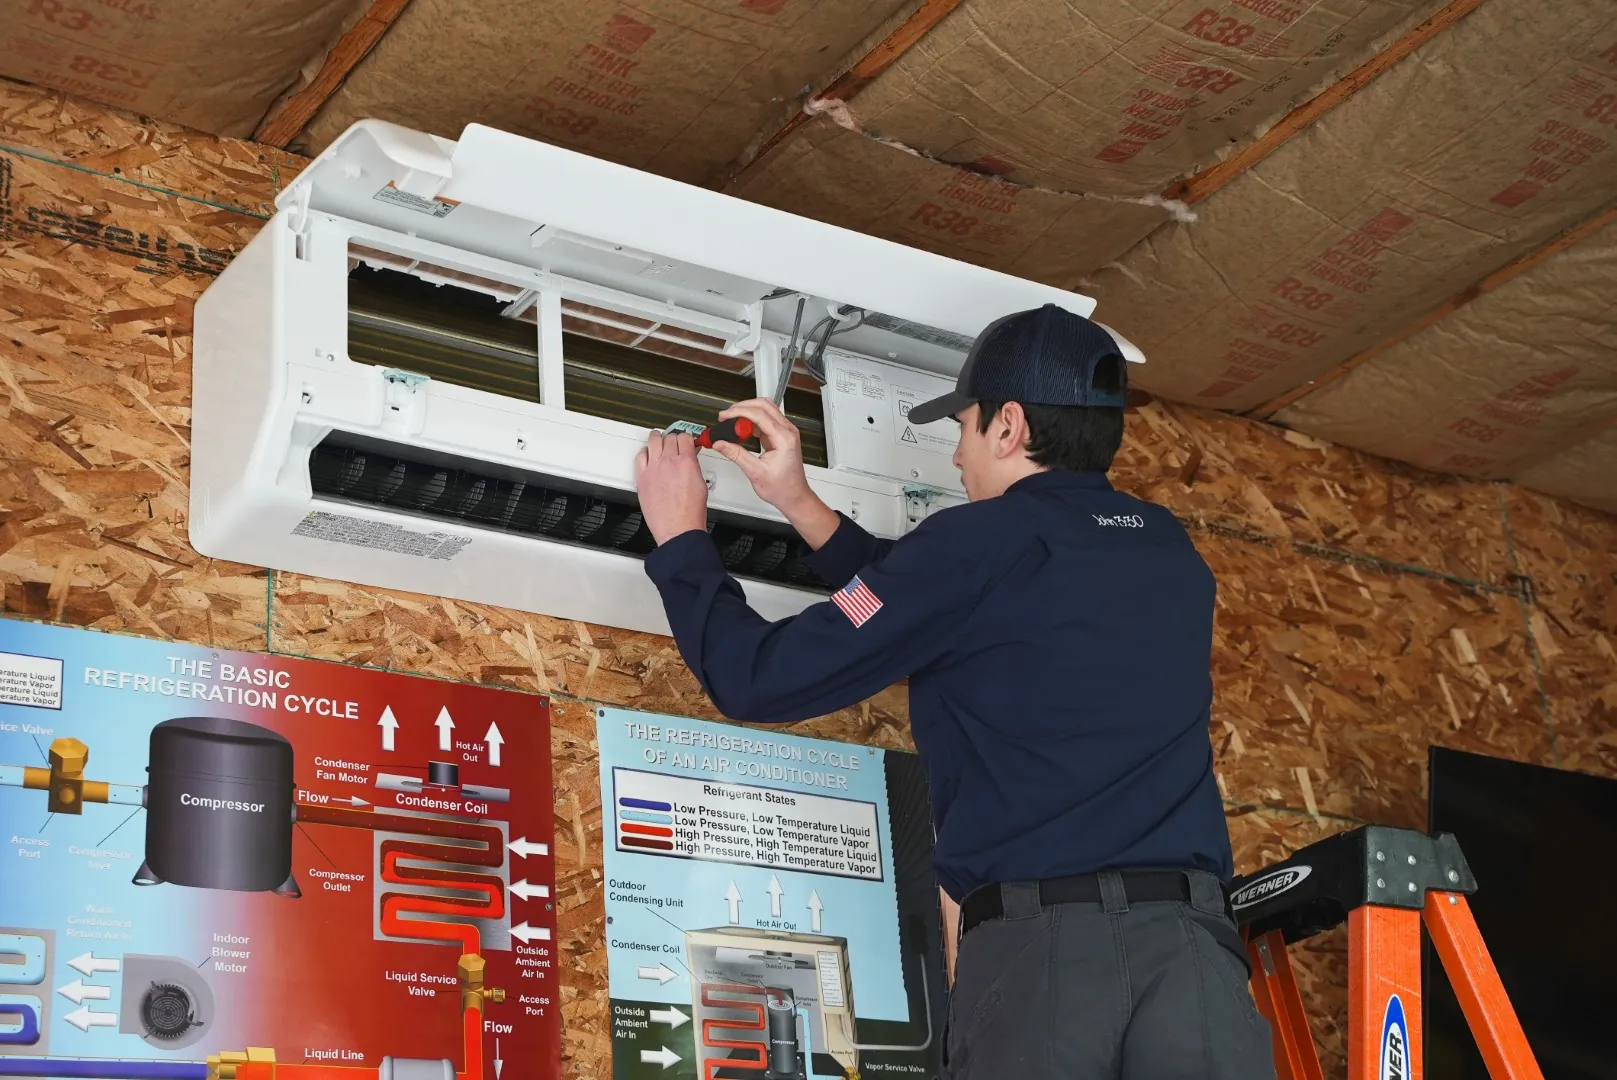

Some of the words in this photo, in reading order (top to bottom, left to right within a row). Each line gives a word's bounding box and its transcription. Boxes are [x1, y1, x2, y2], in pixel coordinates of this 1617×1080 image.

[1181, 8, 1256, 48] R38
[1174, 66, 1245, 95] R38
[1118, 121, 1171, 141] PINK
[938, 182, 1018, 214] FIBERGLAS
[909, 202, 979, 237] R38
[1270, 277, 1334, 311] R38
[30, 672, 56, 682] Liquid
[166, 656, 213, 680] THE
[219, 664, 291, 690] BASIC
[29, 680, 54, 689] Vapor
[0, 685, 30, 694] erature
[33, 688, 59, 698] Liquid
[83, 666, 277, 710] REFRIGERATION
[284, 694, 359, 720] CYCLE
[32, 696, 57, 706] Vapor
[22, 723, 54, 736] Valve
[456, 741, 471, 751] Hot
[472, 743, 484, 752] Air
[625, 721, 661, 742] THE
[665, 727, 802, 762] REFRIGERATION
[807, 749, 861, 771] CYCLE
[462, 752, 478, 762] Out
[314, 756, 370, 772] Condenser
[643, 748, 668, 765] OF
[671, 752, 698, 770] AN
[701, 755, 732, 774] AIR
[735, 760, 849, 792] CONDITIONER
[316, 770, 338, 782] Fan
[340, 771, 368, 785] Motor
[298, 790, 329, 804] Flow
[703, 784, 762, 801] Refrigerant
[765, 792, 796, 806] States
[180, 792, 265, 814] Compressor
[395, 793, 461, 813] Condenser
[464, 800, 489, 815] Coil
[674, 802, 696, 814] Low
[699, 805, 749, 822] Pressure,
[752, 812, 774, 824] Low
[776, 815, 838, 833] Temperature
[840, 824, 871, 838] Liquid
[674, 814, 697, 827] Low
[700, 818, 750, 835] Pressure,
[753, 824, 774, 836] Low
[777, 827, 839, 845] Temperature
[841, 836, 870, 850] Vapor
[10, 835, 51, 847] Access
[675, 827, 700, 841] High
[703, 830, 753, 847] Pressure,
[756, 837, 780, 851] High
[782, 840, 844, 858] Temperature
[846, 849, 877, 863] Liquid
[18, 848, 42, 859] Port
[675, 840, 700, 854] High
[704, 843, 754, 860] Pressure,
[756, 849, 780, 864] High
[782, 853, 845, 871] Temperature
[847, 861, 876, 875] Vapor
[309, 868, 365, 882] Compressor
[323, 881, 351, 892] Outlet
[609, 879, 646, 891] Outdoor
[1237, 871, 1295, 905] WERNER
[609, 892, 663, 908] Condensing
[665, 898, 684, 908] Unit
[756, 919, 770, 928] Hot
[771, 920, 782, 929] Air
[783, 921, 797, 931] Out
[213, 932, 251, 944] Indoor
[212, 946, 251, 959] Blower
[516, 945, 549, 956] Outside
[611, 939, 660, 952] Condenser
[662, 944, 680, 954] Coil
[214, 961, 248, 973] Motor
[515, 957, 551, 968] Ambient
[385, 970, 418, 984] Liquid
[420, 972, 458, 985] Service
[521, 969, 534, 978] Air
[536, 970, 545, 979] In
[408, 985, 436, 997] Valve
[518, 994, 550, 1005] Access
[525, 1006, 544, 1016] Port
[614, 1006, 645, 1017] Outside
[484, 1021, 513, 1034] Flow
[615, 1018, 648, 1029] Ambient
[616, 1030, 628, 1039] Air
[628, 1030, 637, 1039] In
[304, 1048, 339, 1060] Liquid
[341, 1049, 364, 1061] Line
[865, 1062, 884, 1072] Vapor
[885, 1064, 908, 1073] Service
[909, 1065, 926, 1073] Valve
